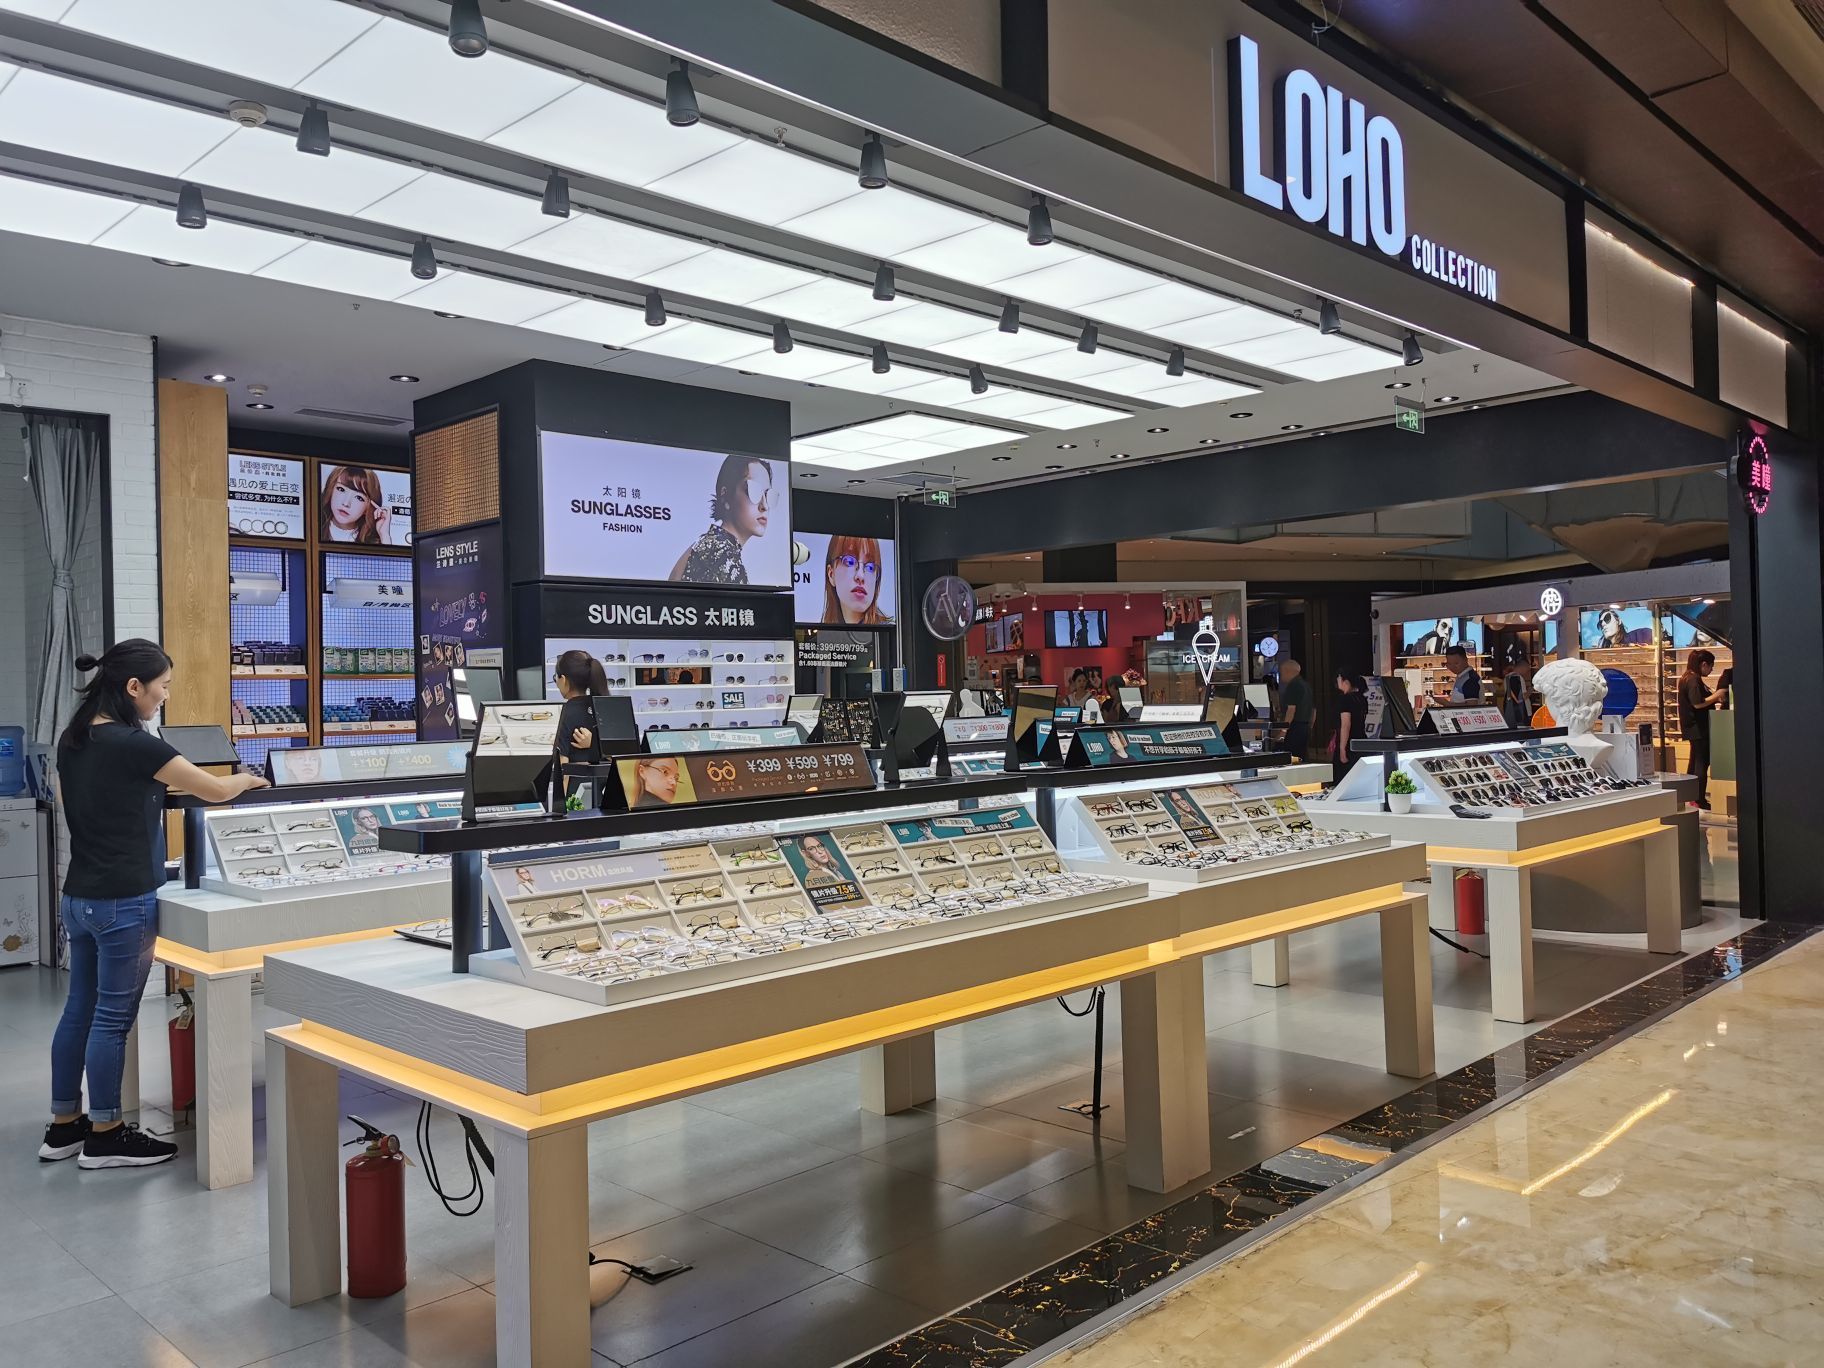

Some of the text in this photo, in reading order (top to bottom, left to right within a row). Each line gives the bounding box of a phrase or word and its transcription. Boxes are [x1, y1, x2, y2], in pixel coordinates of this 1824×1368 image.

[1240, 34, 1407, 256] LOHO
[1411, 234, 1498, 302] COLLECTION
[602, 485, 641, 499] 太阳镜
[570, 499, 672, 521] SUNGLASSES
[602, 522, 643, 533] FASHION
[436, 540, 479, 560] LENS STYLE
[377, 584, 404, 596] 美瞳
[587, 604, 755, 627] SUNGLASS 太阳镜
[798, 652, 857, 661] Packaged Service
[1182, 654, 1231, 664] ICE CREAM
[723, 692, 744, 703] SALE
[746, 753, 855, 773] ¥399 ¥599 ¥799
[550, 864, 607, 883] HORM
